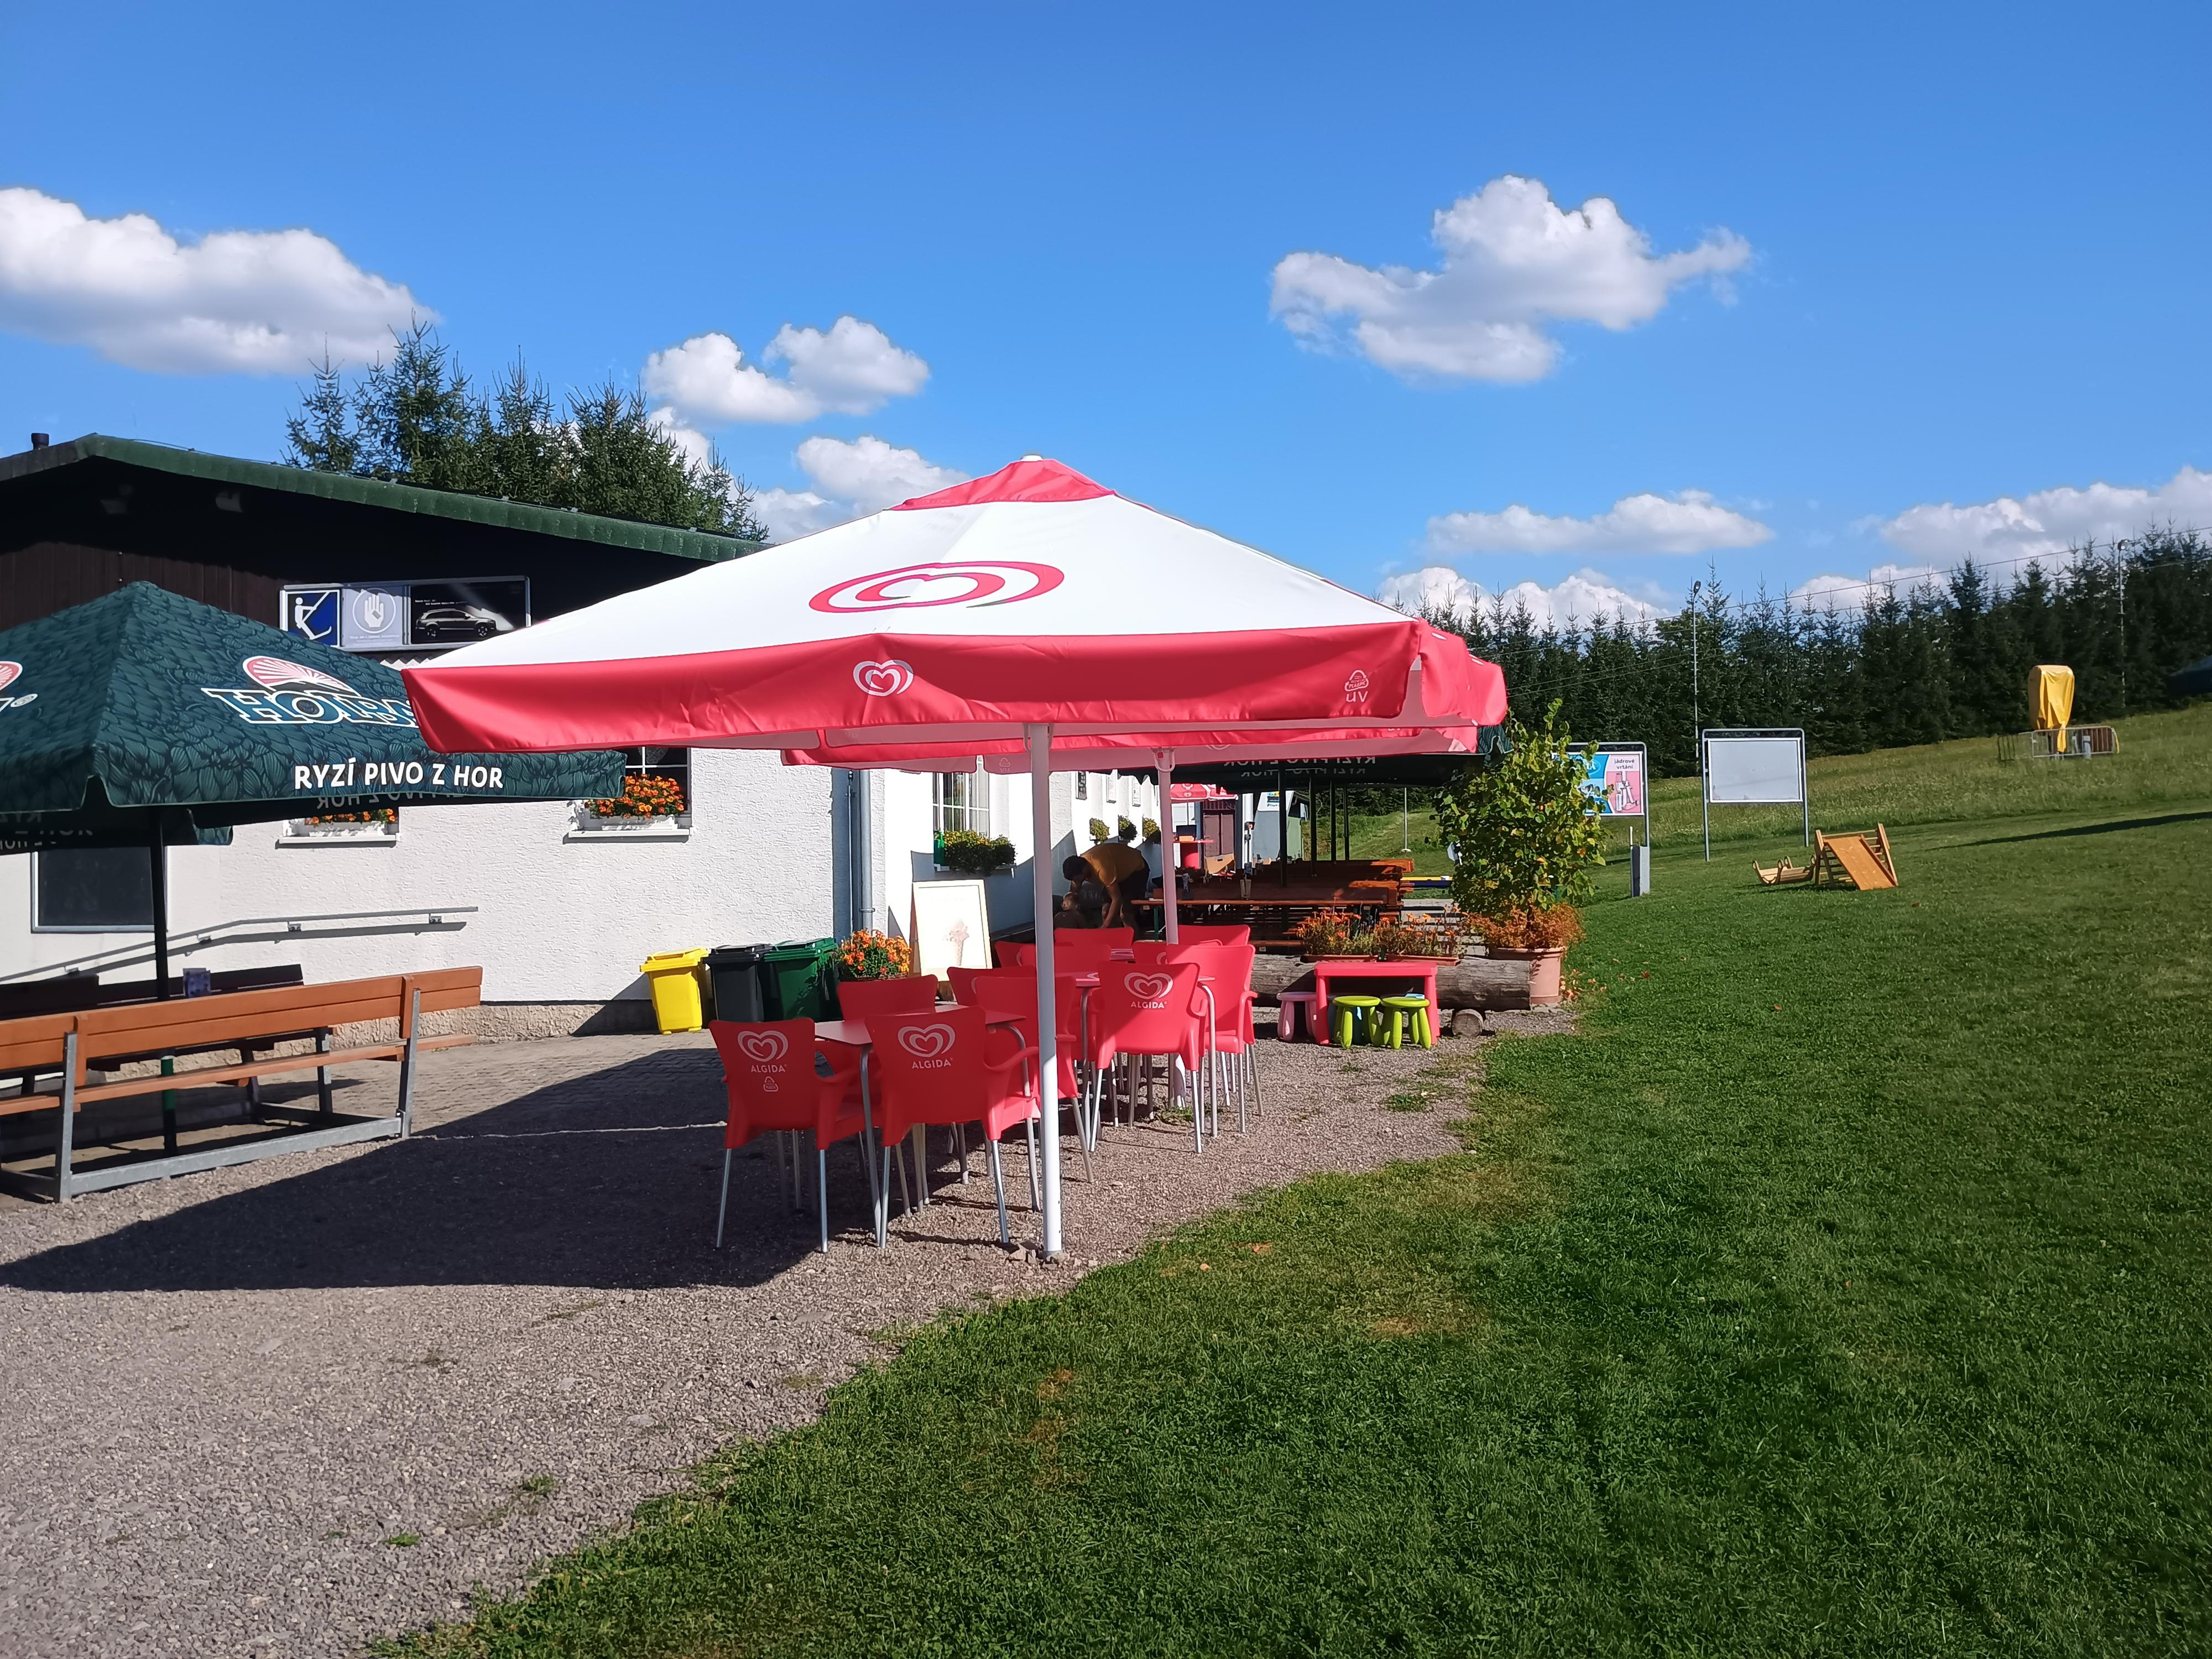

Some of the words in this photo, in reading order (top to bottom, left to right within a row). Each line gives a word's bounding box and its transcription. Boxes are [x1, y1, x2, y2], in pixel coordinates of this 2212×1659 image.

[294, 757, 356, 790] RYZÍ
[364, 761, 424, 785] PIVO
[432, 763, 445, 785] Z
[453, 765, 503, 789] HOR
[1130, 1001, 1165, 1009] ALGIDA
[750, 1065, 786, 1073] ALGIDA
[912, 1058, 952, 1070] ALGIDA
